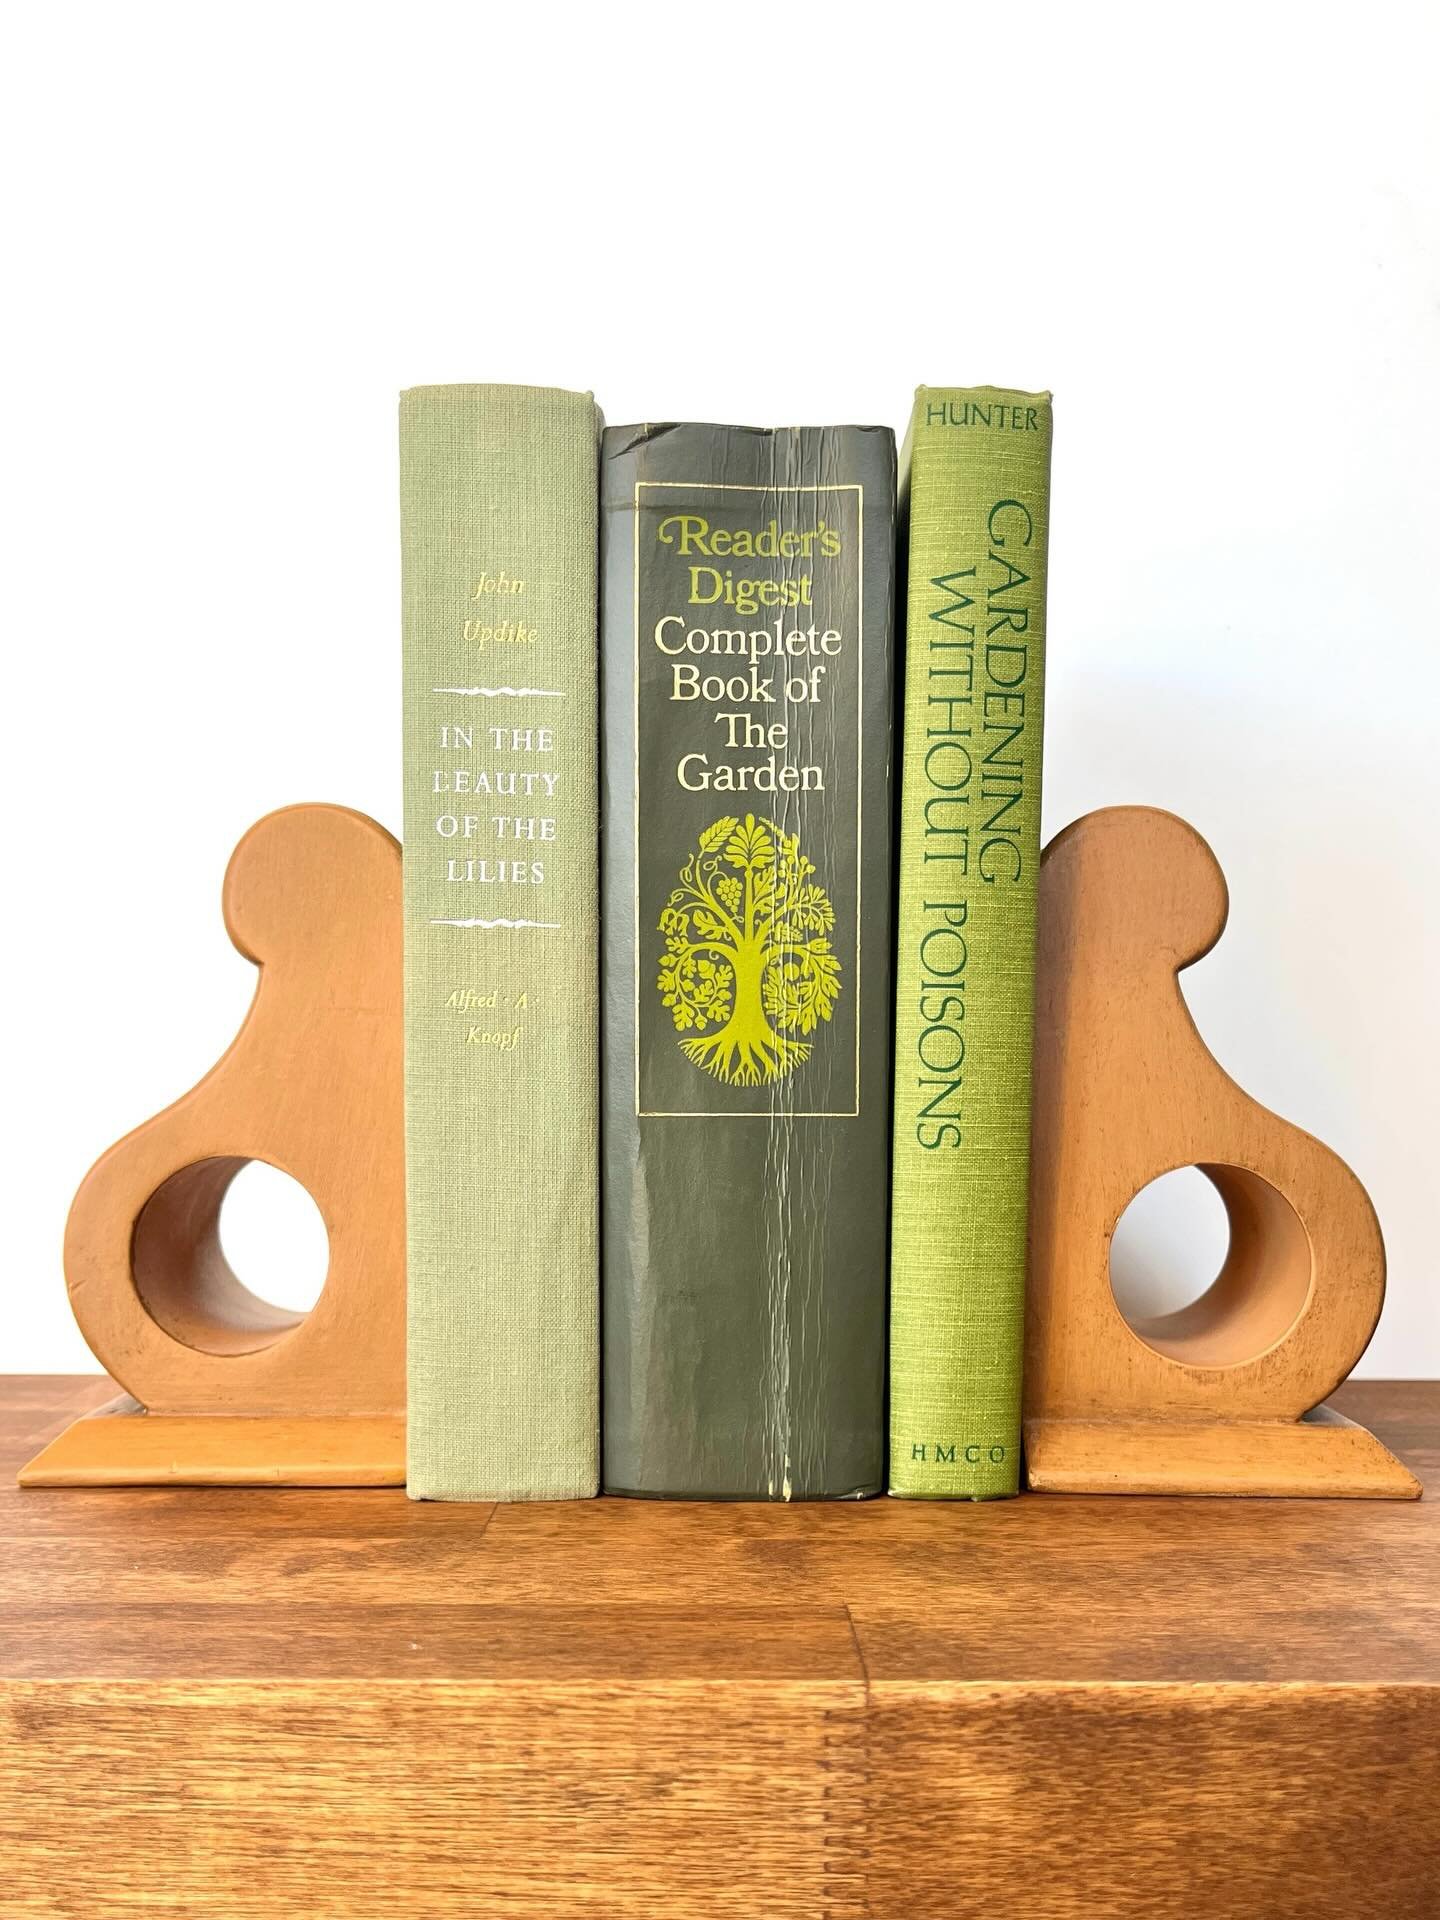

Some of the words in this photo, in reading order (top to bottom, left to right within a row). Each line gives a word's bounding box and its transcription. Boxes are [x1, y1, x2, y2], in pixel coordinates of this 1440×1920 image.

[927, 403, 1039, 430] HUNTER
[658, 515, 843, 557] Reader's
[471, 571, 525, 600] John
[687, 566, 813, 615] Digest
[462, 620, 538, 650] Updike
[654, 616, 843, 665] Complete
[669, 664, 776, 702] Book
[784, 666, 826, 703] of
[979, 499, 1033, 884] GARDENING
[440, 726, 473, 748] IN
[489, 728, 554, 752] THE
[714, 712, 788, 749] The
[924, 566, 977, 877] WITHOUT
[676, 754, 825, 792] Garden
[436, 815, 479, 838] OF
[491, 817, 556, 841] THE
[446, 860, 545, 884] LILIES
[445, 989, 498, 1014] Alfred
[466, 1026, 524, 1051] Knopf
[916, 900, 968, 1150] POISONS
